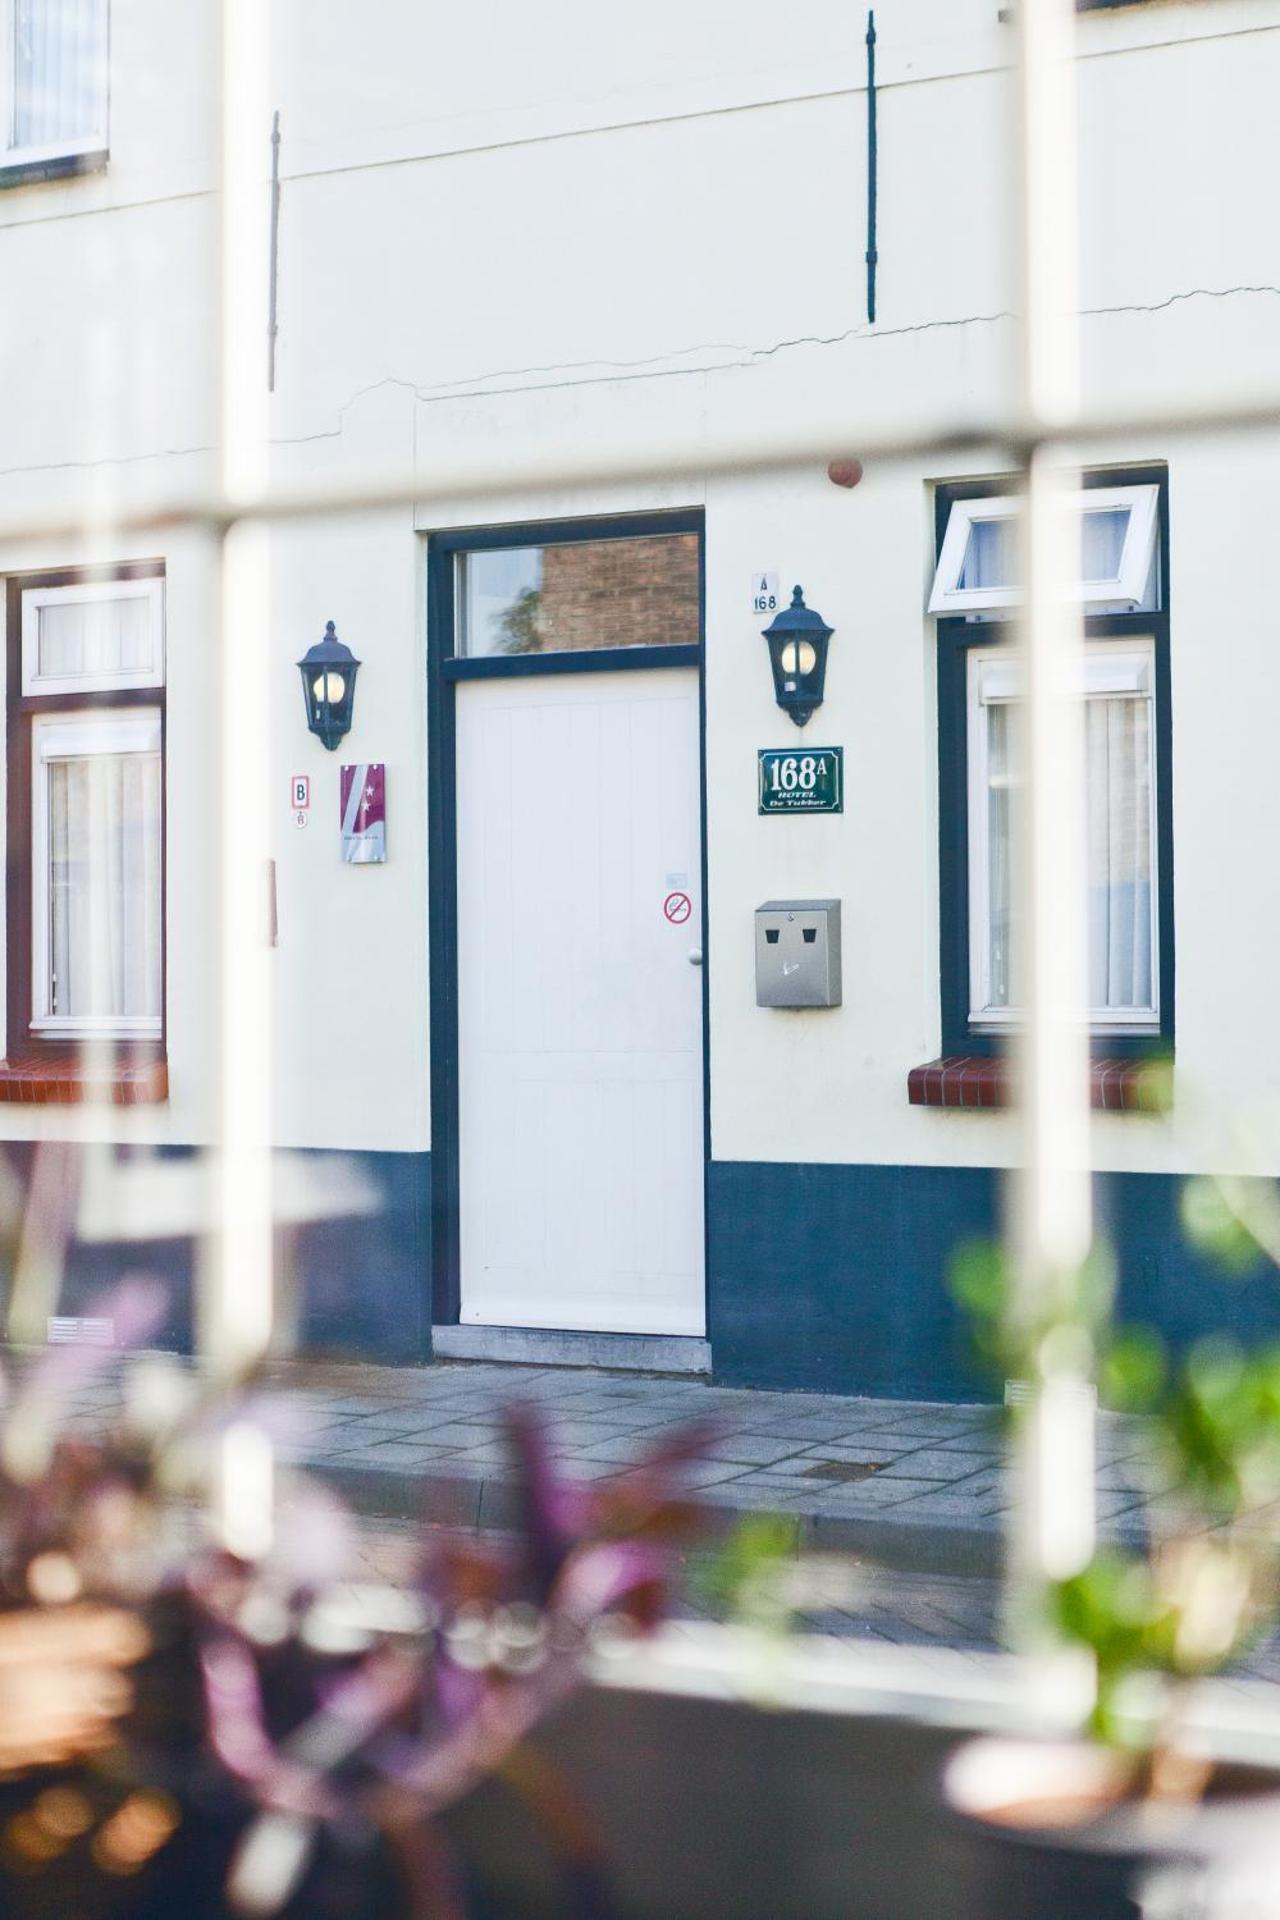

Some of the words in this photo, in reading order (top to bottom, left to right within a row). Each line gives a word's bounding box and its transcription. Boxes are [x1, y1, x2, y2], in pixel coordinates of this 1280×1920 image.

[754, 595, 776, 610] 168
[297, 784, 305, 800] B
[778, 791, 817, 799] HOTEL
